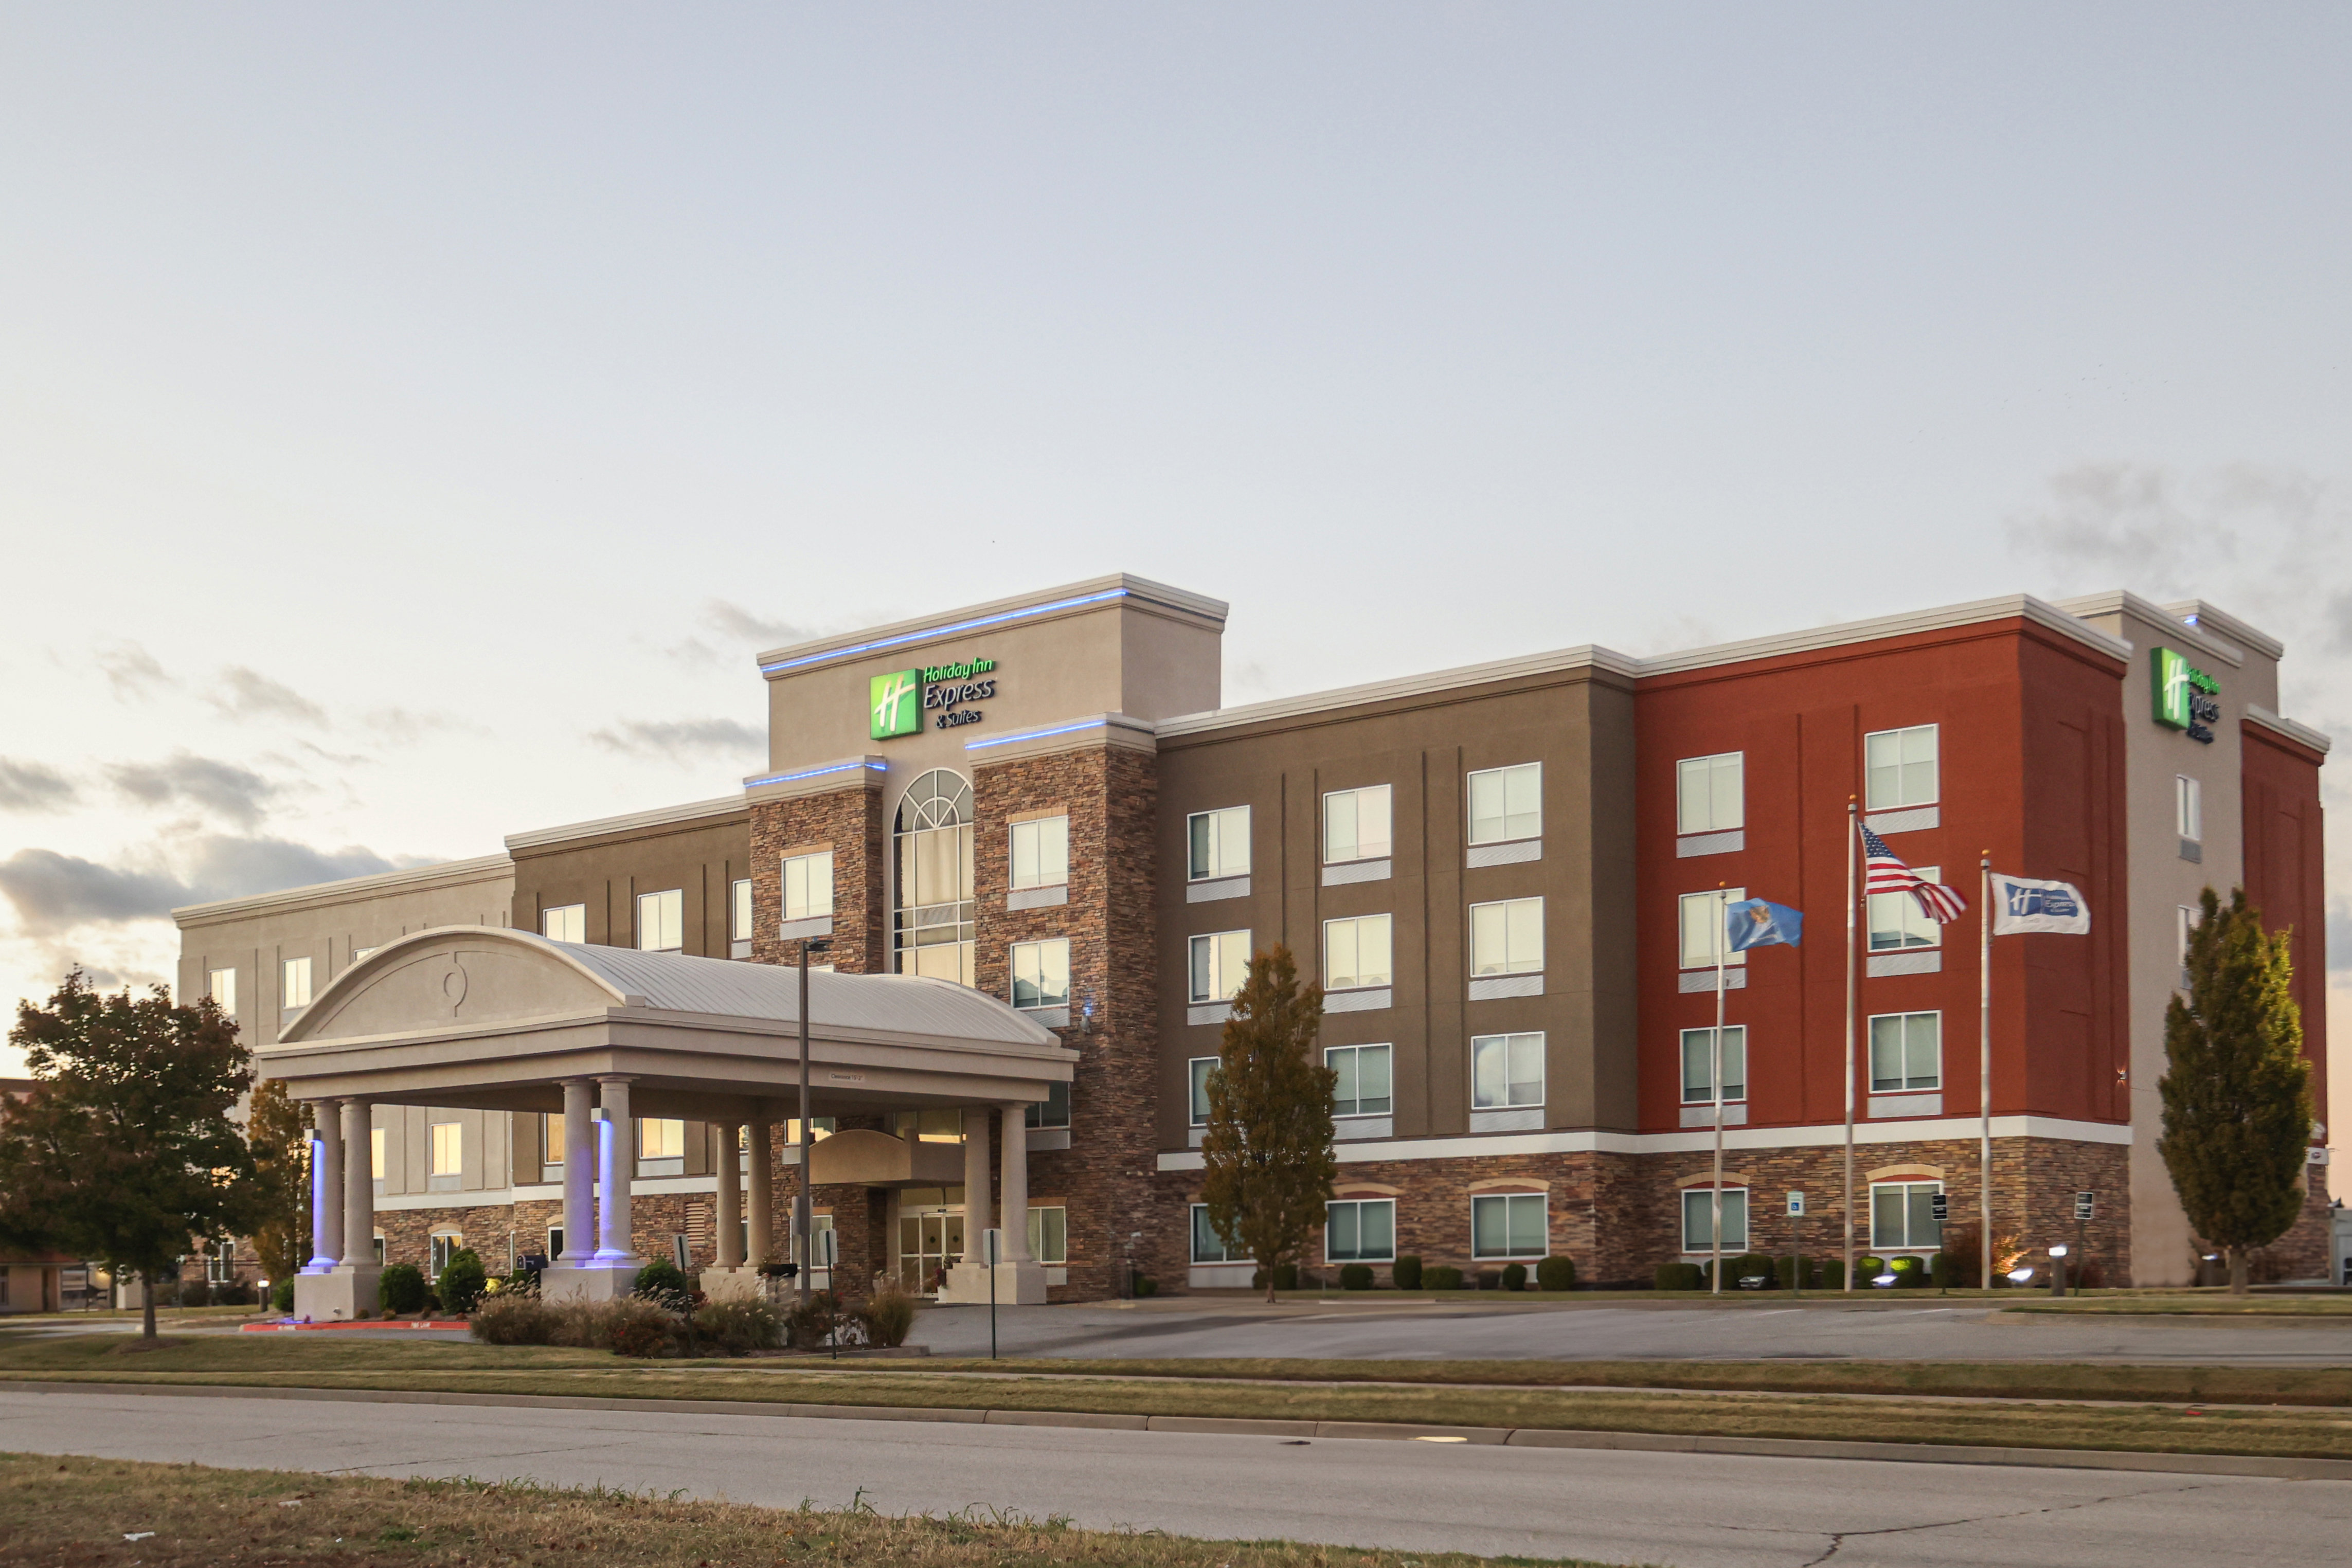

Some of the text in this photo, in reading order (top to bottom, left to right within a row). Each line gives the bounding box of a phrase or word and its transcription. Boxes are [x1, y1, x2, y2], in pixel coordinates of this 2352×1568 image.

[923, 657, 994, 683] Holiday Inn
[924, 679, 994, 710] Express
[935, 710, 980, 728] & Suites
